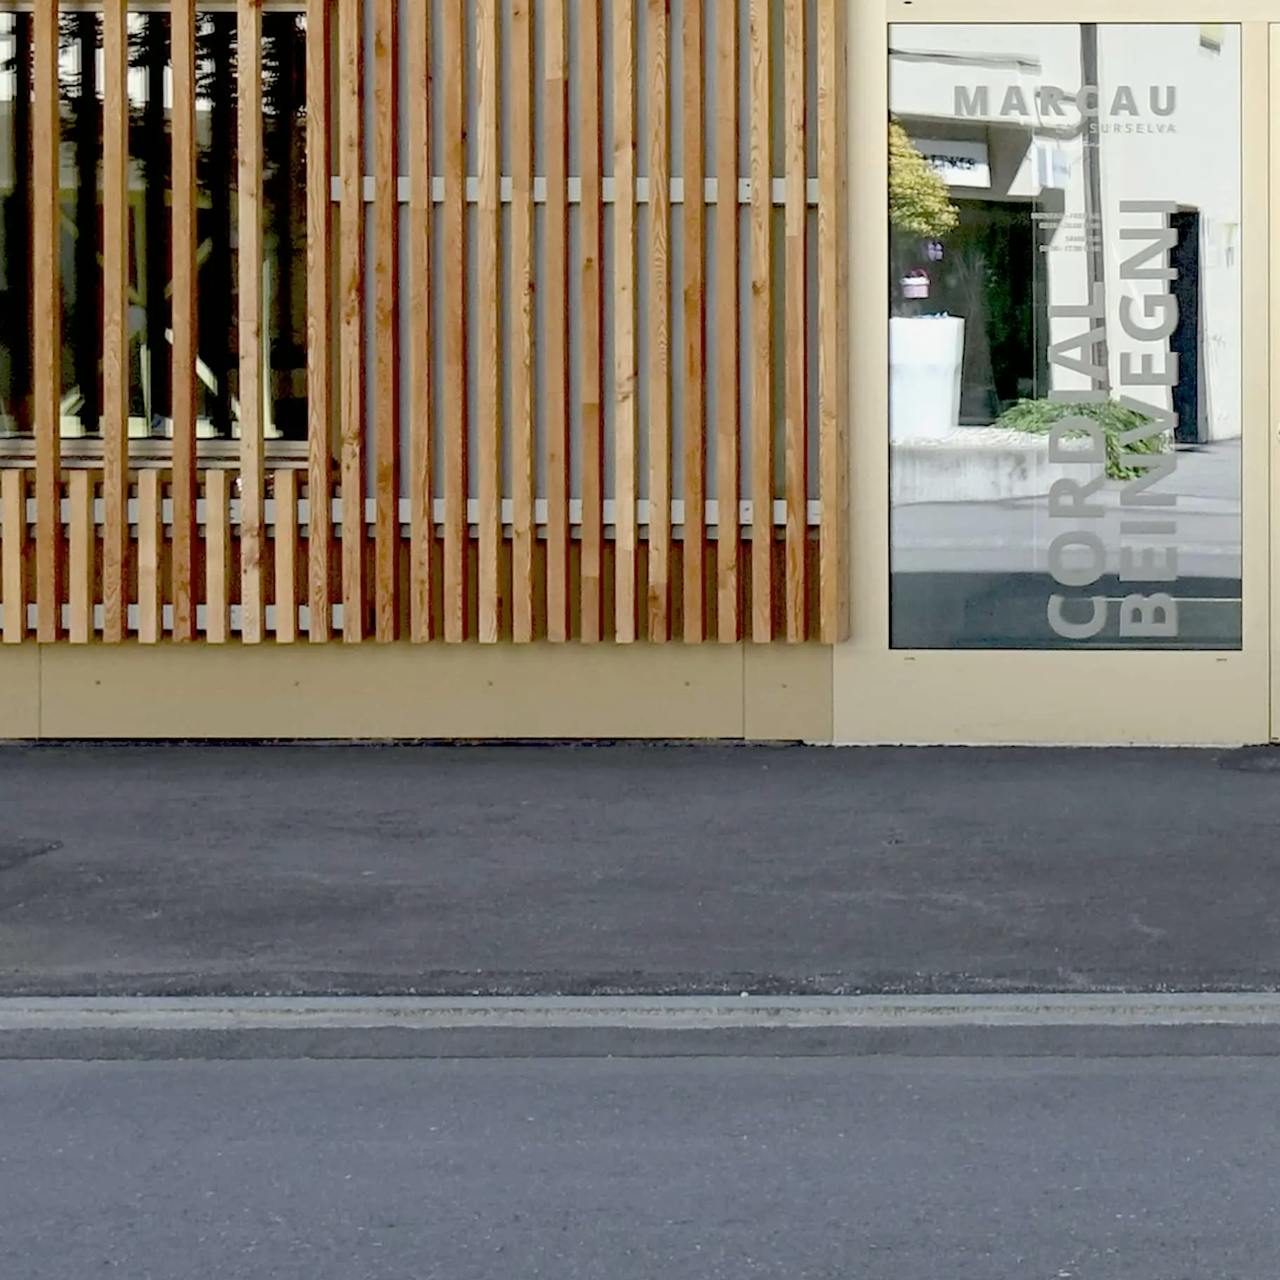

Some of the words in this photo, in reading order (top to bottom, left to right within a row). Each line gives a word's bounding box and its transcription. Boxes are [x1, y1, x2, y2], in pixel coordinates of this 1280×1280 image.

[953, 84, 1178, 118] MARCAU
[1089, 123, 1177, 134] SURSELVA
[1047, 281, 1107, 640] CORDIAL
[1120, 200, 1179, 638] BEINVEGNI
